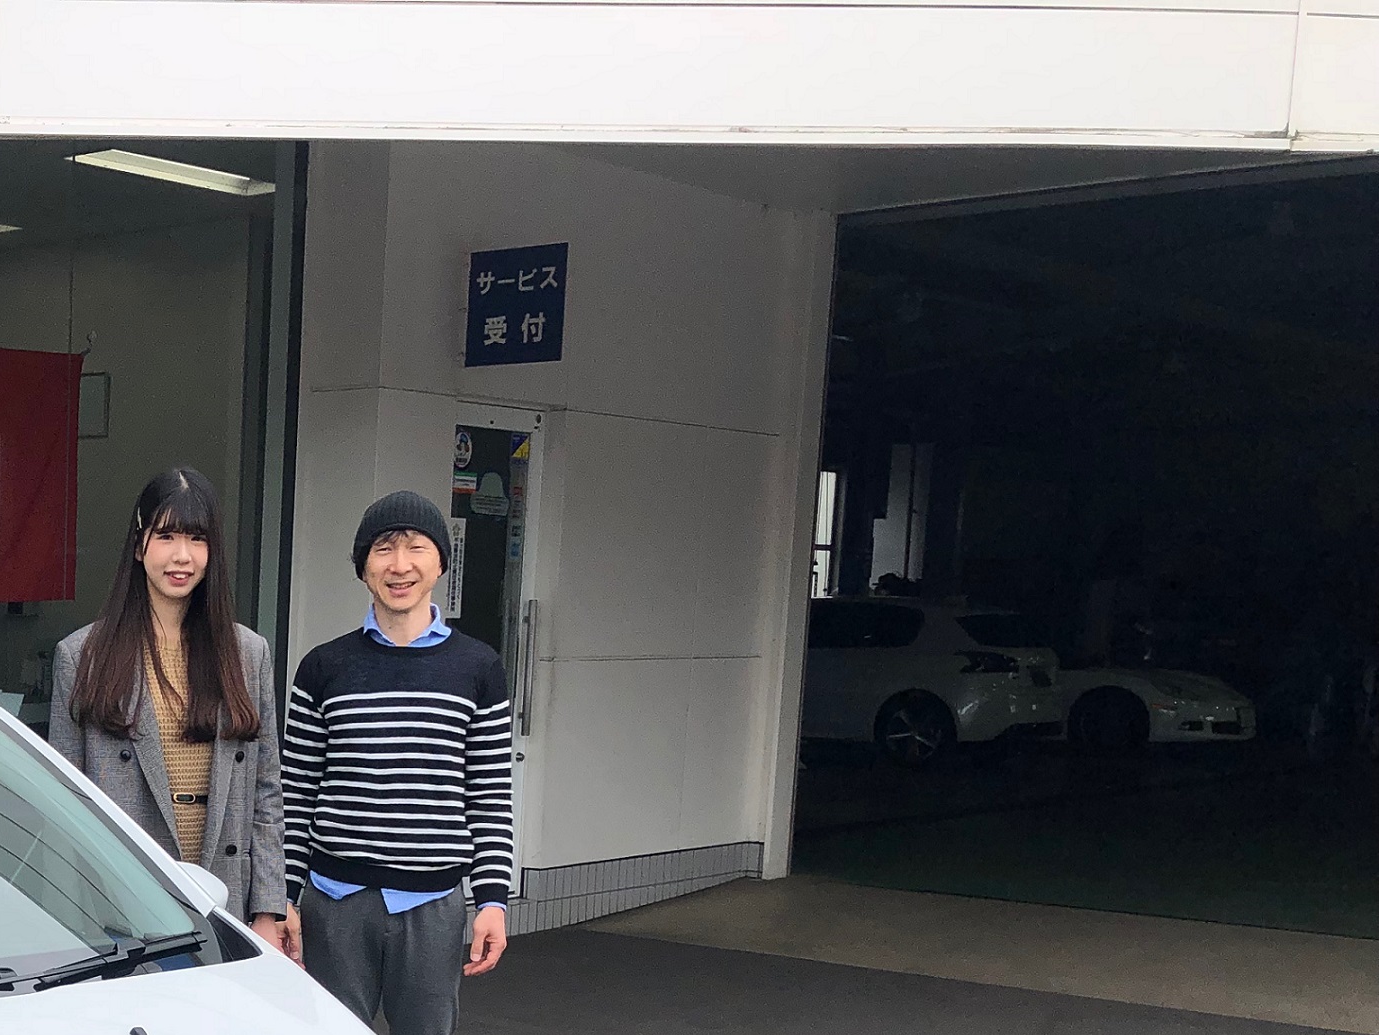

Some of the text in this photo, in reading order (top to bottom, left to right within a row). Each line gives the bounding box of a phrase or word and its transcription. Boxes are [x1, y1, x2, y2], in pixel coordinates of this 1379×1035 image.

[477, 266, 558, 295] サービス
[483, 312, 546, 346] 受付
